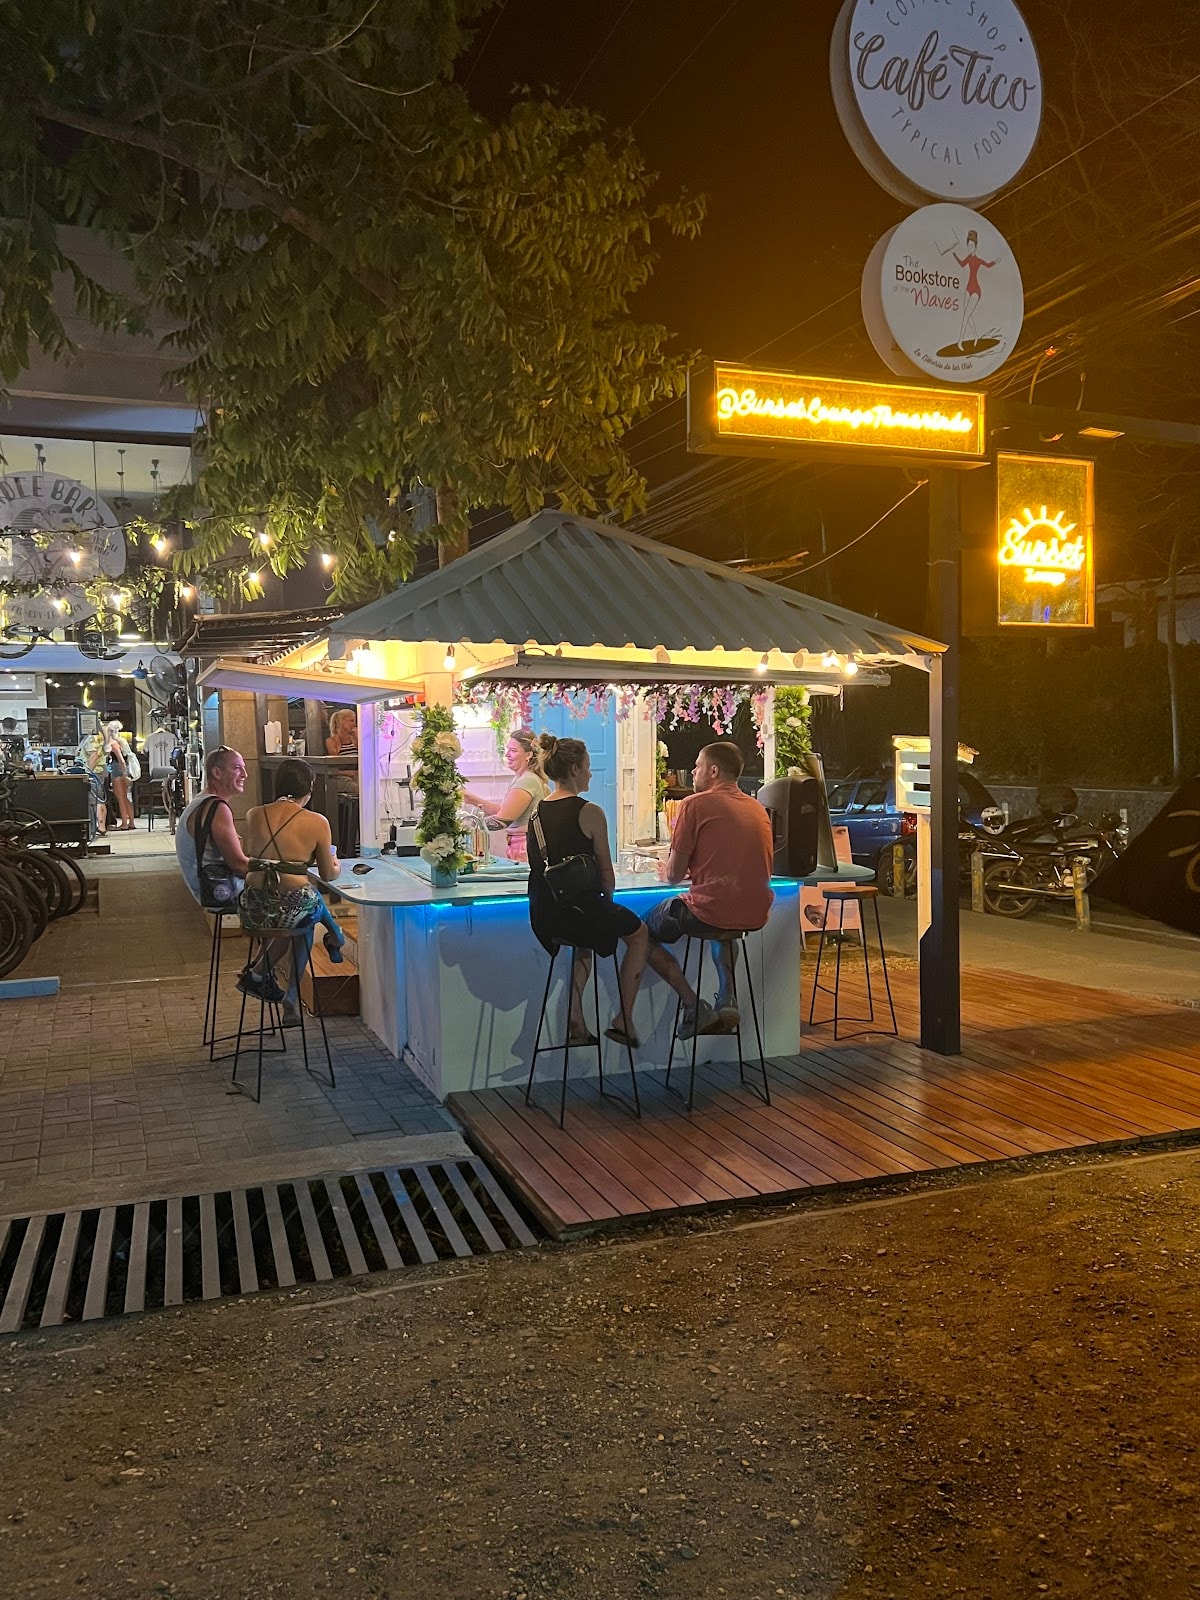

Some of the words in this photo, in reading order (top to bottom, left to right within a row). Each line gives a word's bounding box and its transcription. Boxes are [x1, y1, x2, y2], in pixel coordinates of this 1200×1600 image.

[967, 1, 1007, 51] SHOP
[853, 30, 951, 111] Café
[949, 45, 1036, 111] Tico
[891, 106, 962, 166] TYPICAL
[973, 120, 1009, 160] FOOD
[895, 264, 960, 289] Bookstore
[903, 255, 919, 268] The
[910, 285, 960, 311] Waves
[51, 479, 95, 516] BAR
[998, 526, 1086, 571] Sunset
